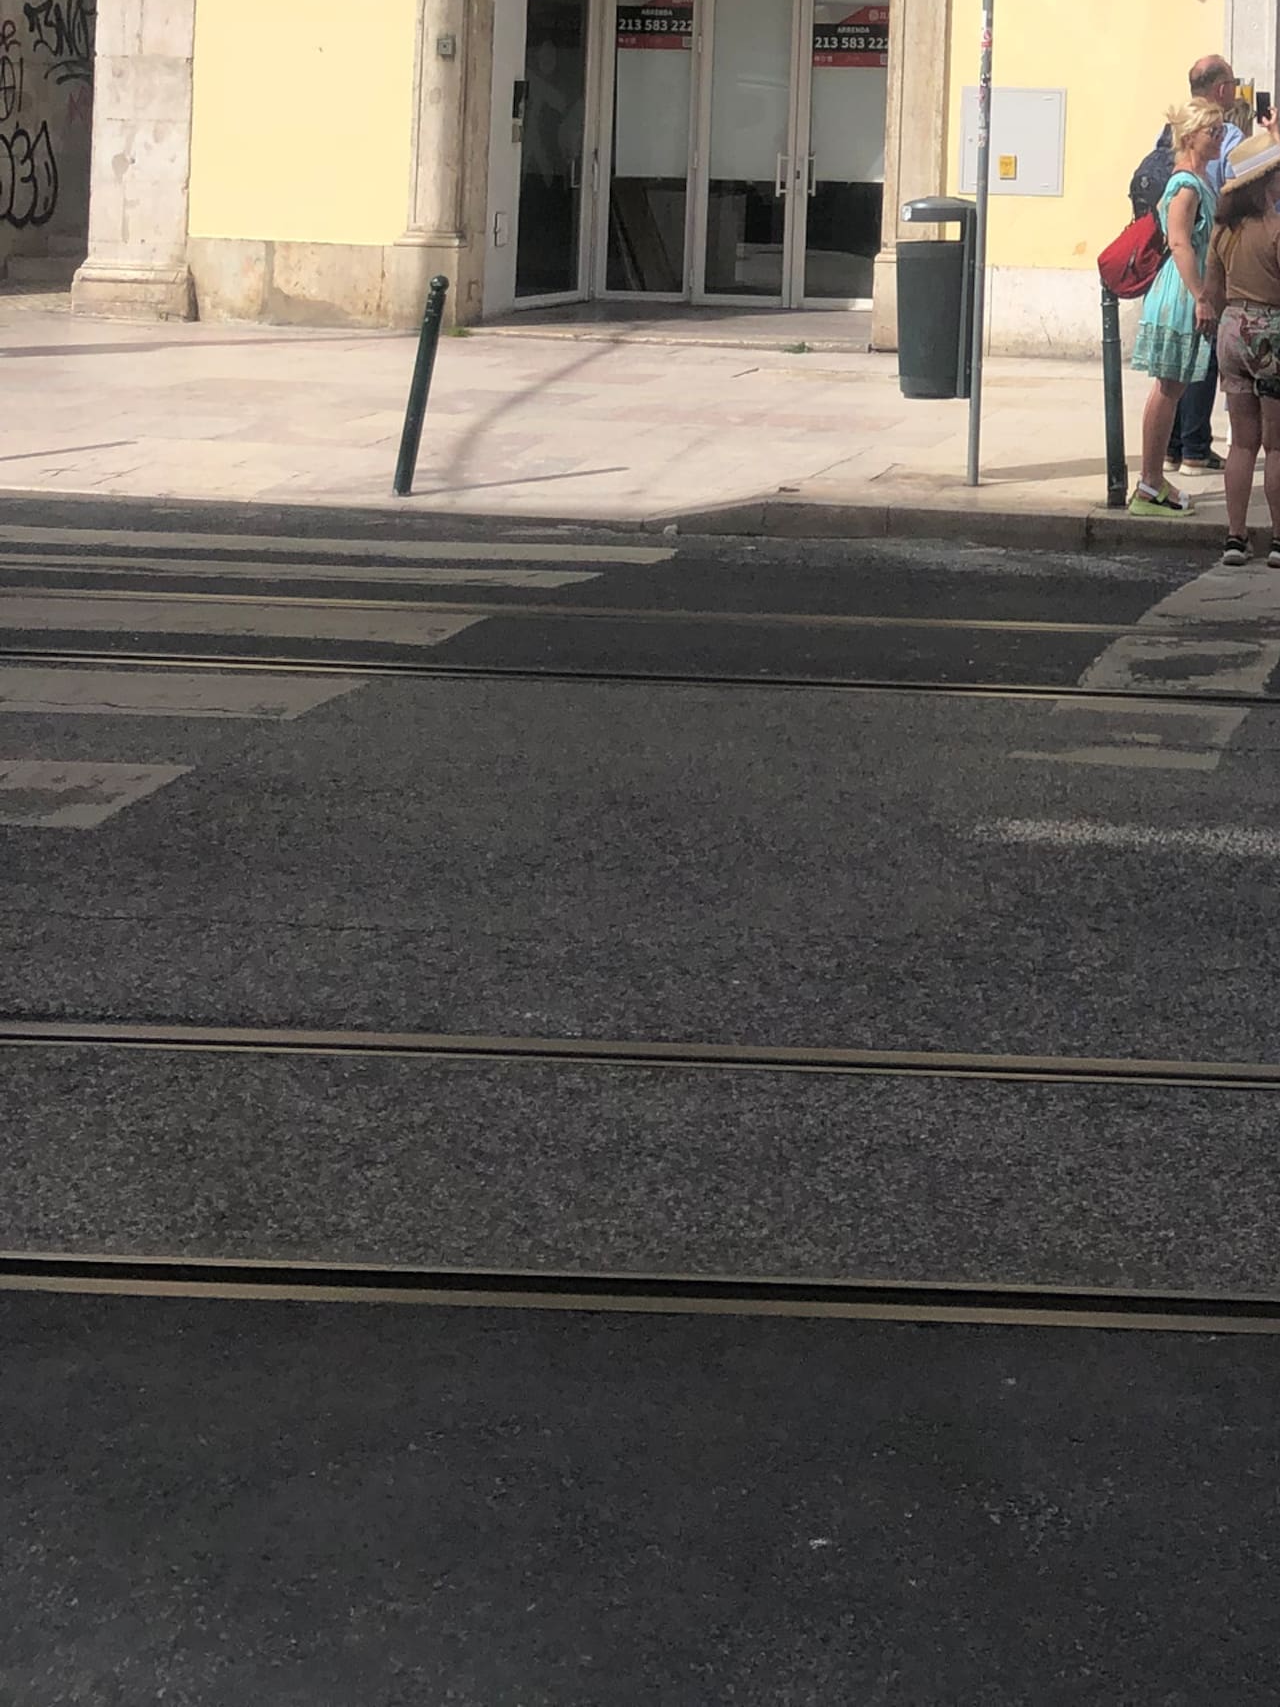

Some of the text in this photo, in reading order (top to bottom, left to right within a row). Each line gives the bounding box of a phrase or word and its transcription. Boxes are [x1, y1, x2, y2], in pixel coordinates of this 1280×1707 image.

[618, 18, 642, 31] 213
[644, 19, 668, 31] 583
[815, 37, 838, 49] 213
[841, 37, 865, 49] 583
